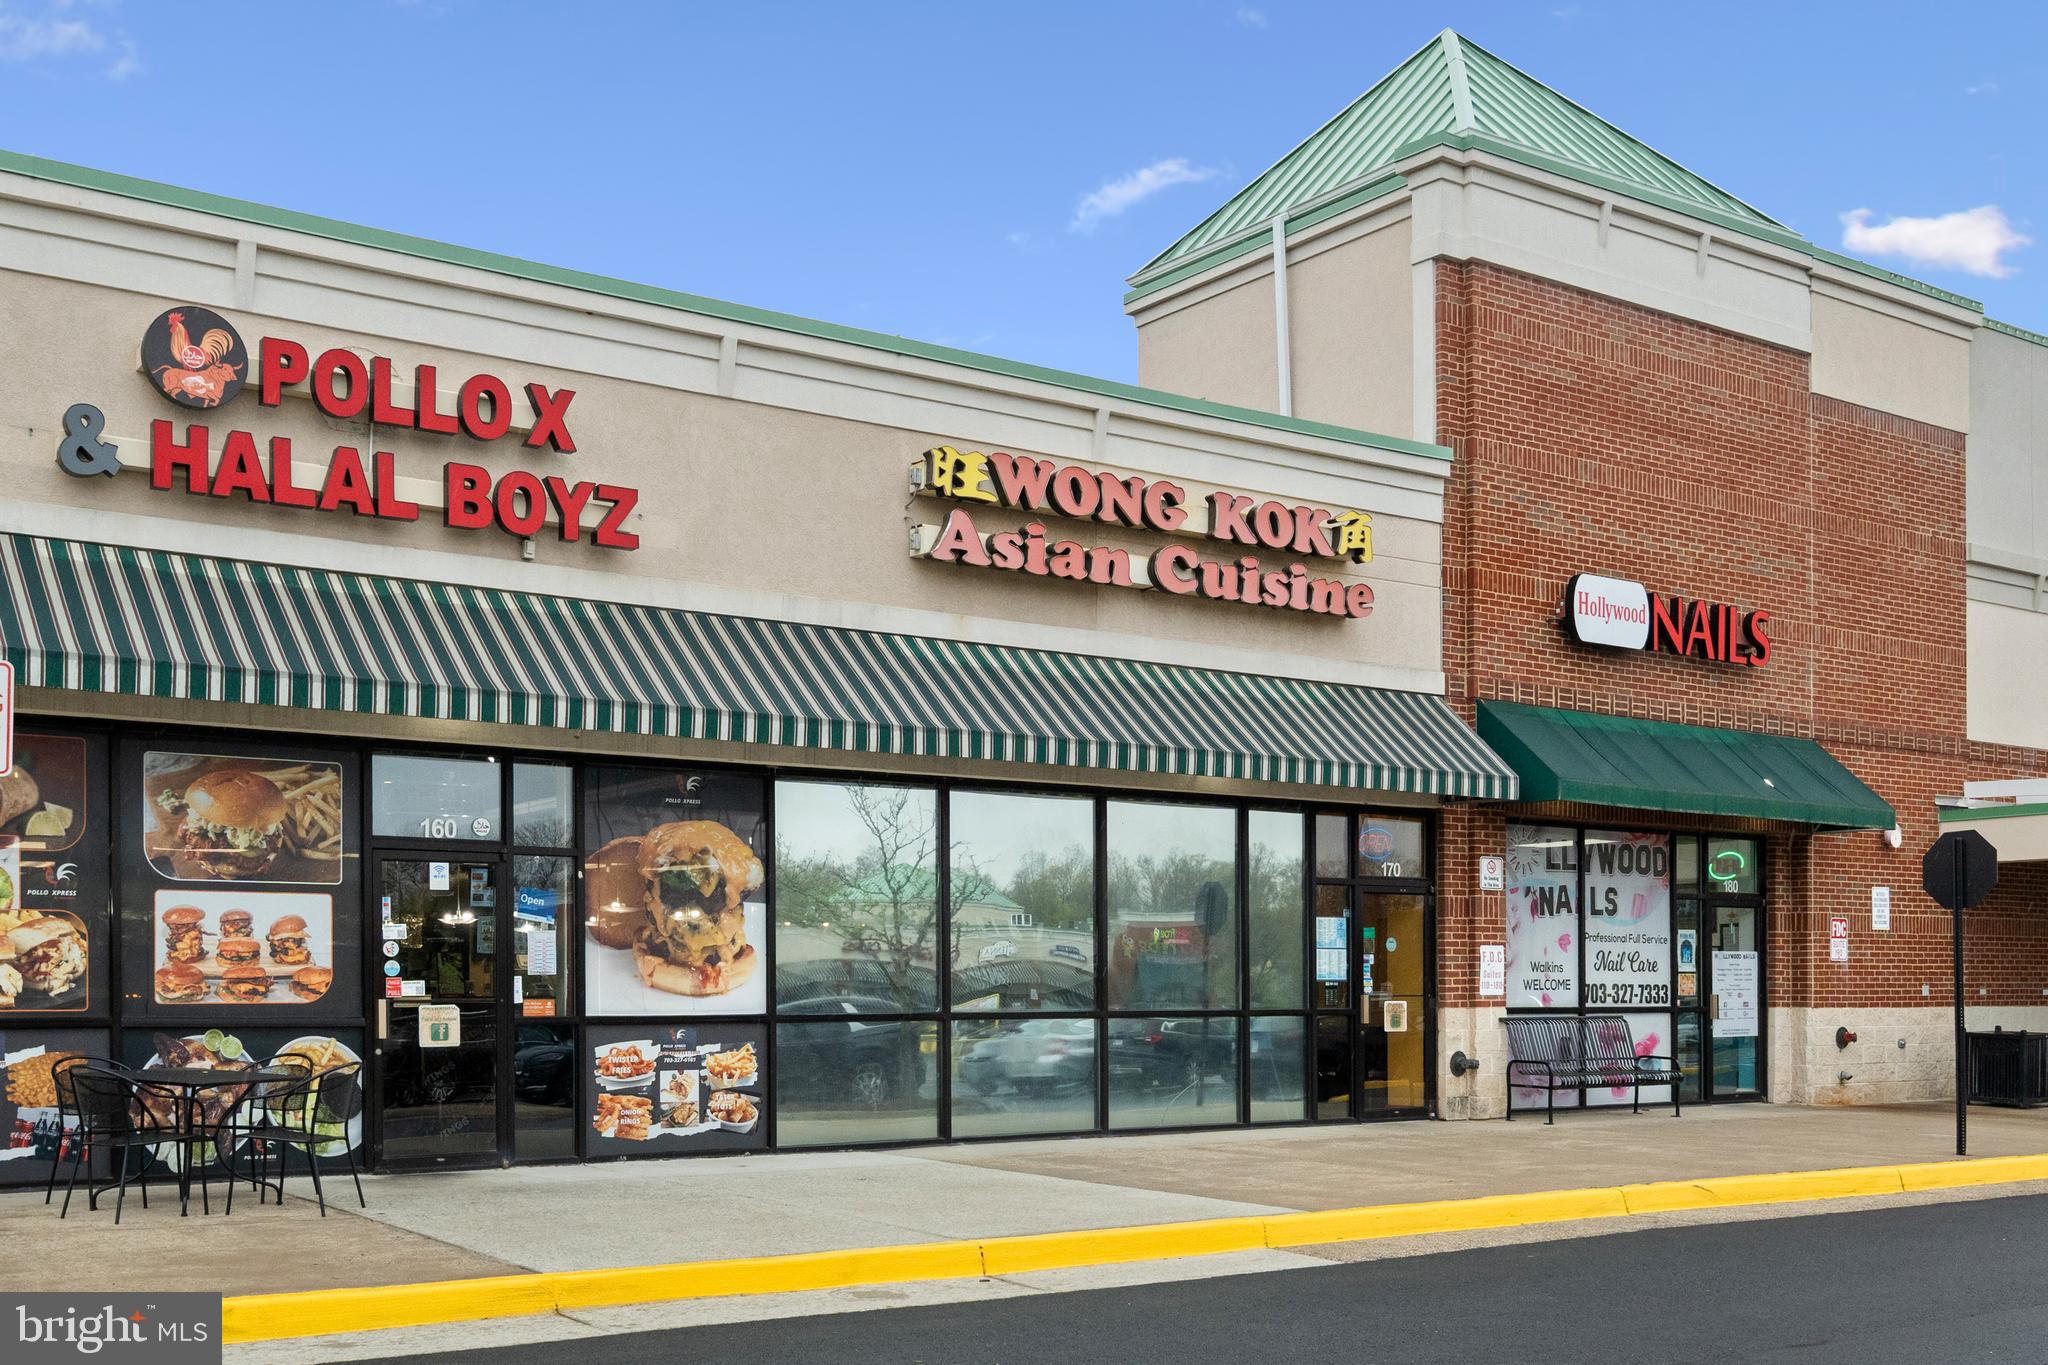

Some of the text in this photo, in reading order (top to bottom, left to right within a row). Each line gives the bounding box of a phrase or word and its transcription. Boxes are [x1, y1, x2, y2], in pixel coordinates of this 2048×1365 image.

[259, 336, 577, 454] POLLO X
[57, 403, 640, 550] & HALAL BOYZ
[987, 452, 1188, 532] WONG
[1205, 491, 1336, 558] KOK
[930, 508, 1375, 619] Asian Cuisine
[1578, 591, 1771, 668] Hollywood NAILS
[420, 818, 457, 838] 160
[1381, 862, 1401, 877] 170
[1723, 880, 1739, 893] 180
[520, 893, 545, 906] Open
[1832, 921, 1847, 937] FDC
[1584, 932, 1628, 945] Professional
[1629, 933, 1641, 945] Full
[1642, 934, 1668, 945] Service
[1530, 961, 1564, 973] Walkins
[1594, 950, 1659, 973] Nail Care
[1523, 979, 1571, 991] WELCOME
[607, 1056, 639, 1064] TWISTER
[612, 1066, 632, 1074] FRIES
